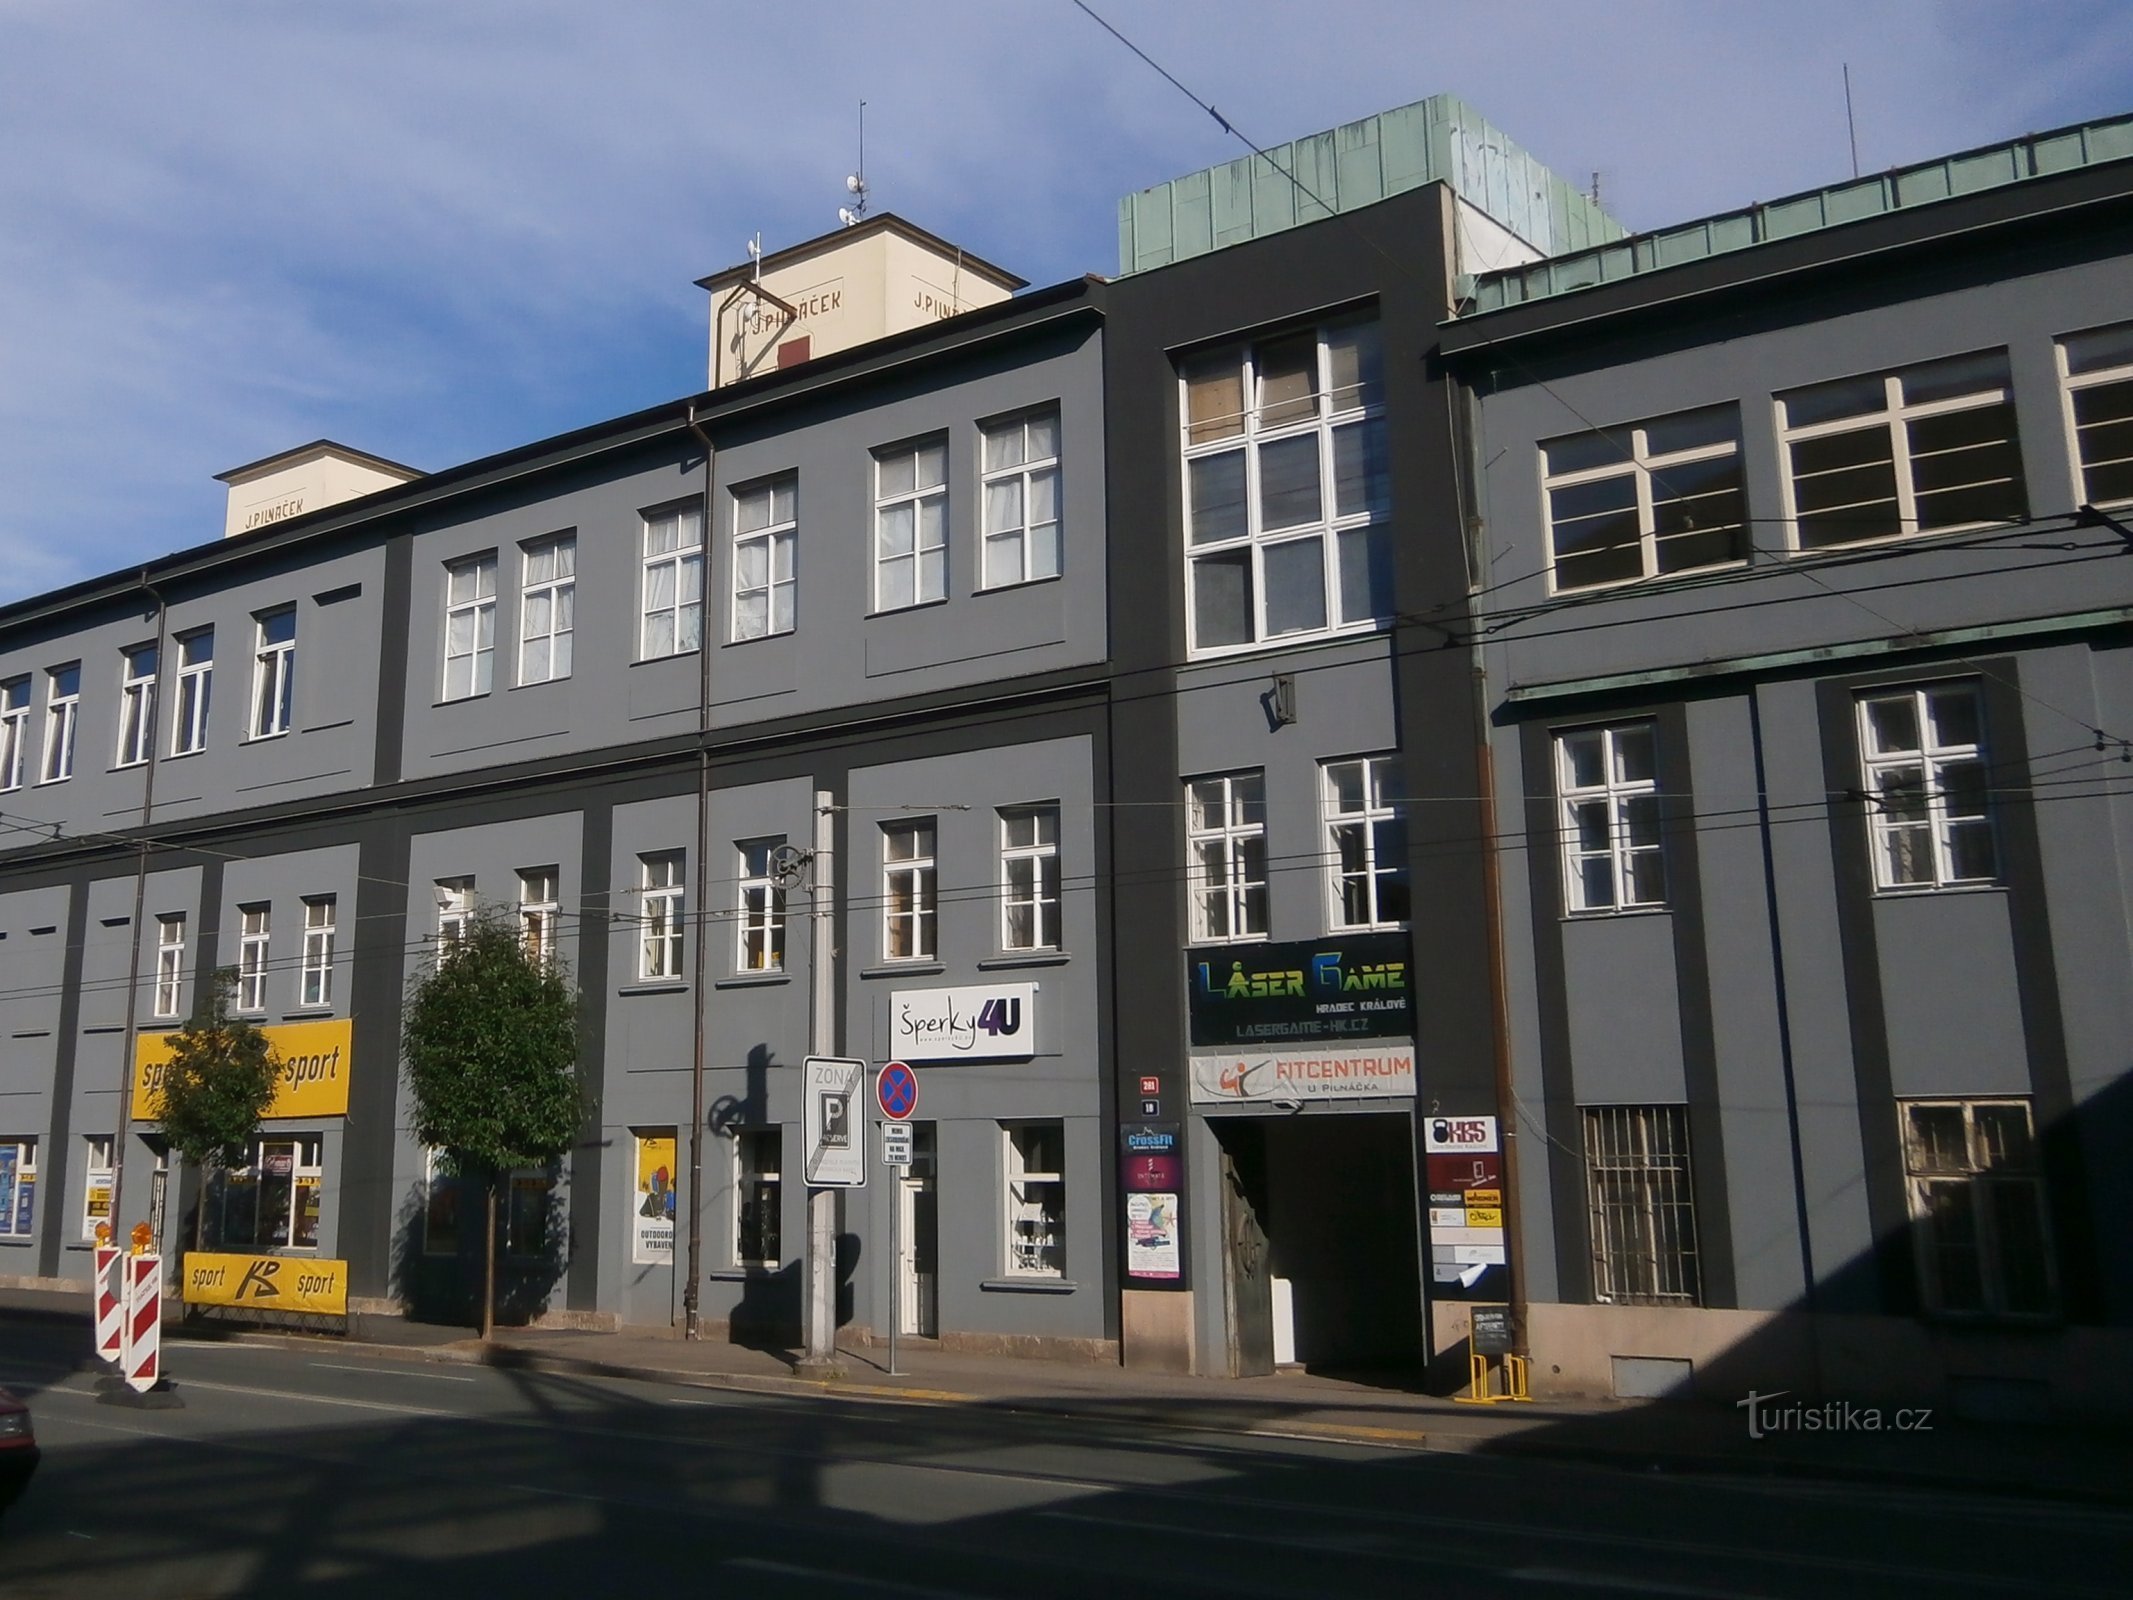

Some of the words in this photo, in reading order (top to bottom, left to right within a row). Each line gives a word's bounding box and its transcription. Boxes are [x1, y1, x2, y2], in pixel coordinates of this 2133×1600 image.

[752, 290, 841, 335] J.PILÁČEK
[245, 498, 304, 529] J.PILNÁČEK
[1315, 1002, 1355, 1014] HRADEC
[1236, 1018, 1369, 1038] LASERGAME-HK.CZ
[285, 1046, 339, 1091] sport
[1276, 1056, 1412, 1080] FITCENTRUM
[1307, 1084, 1317, 1093] U
[825, 1097, 844, 1131] P
[640, 1230, 673, 1239] OUTDOORO
[645, 1240, 673, 1249] VYBAVEN
[192, 1260, 225, 1291] sport
[297, 1271, 335, 1299] sport
